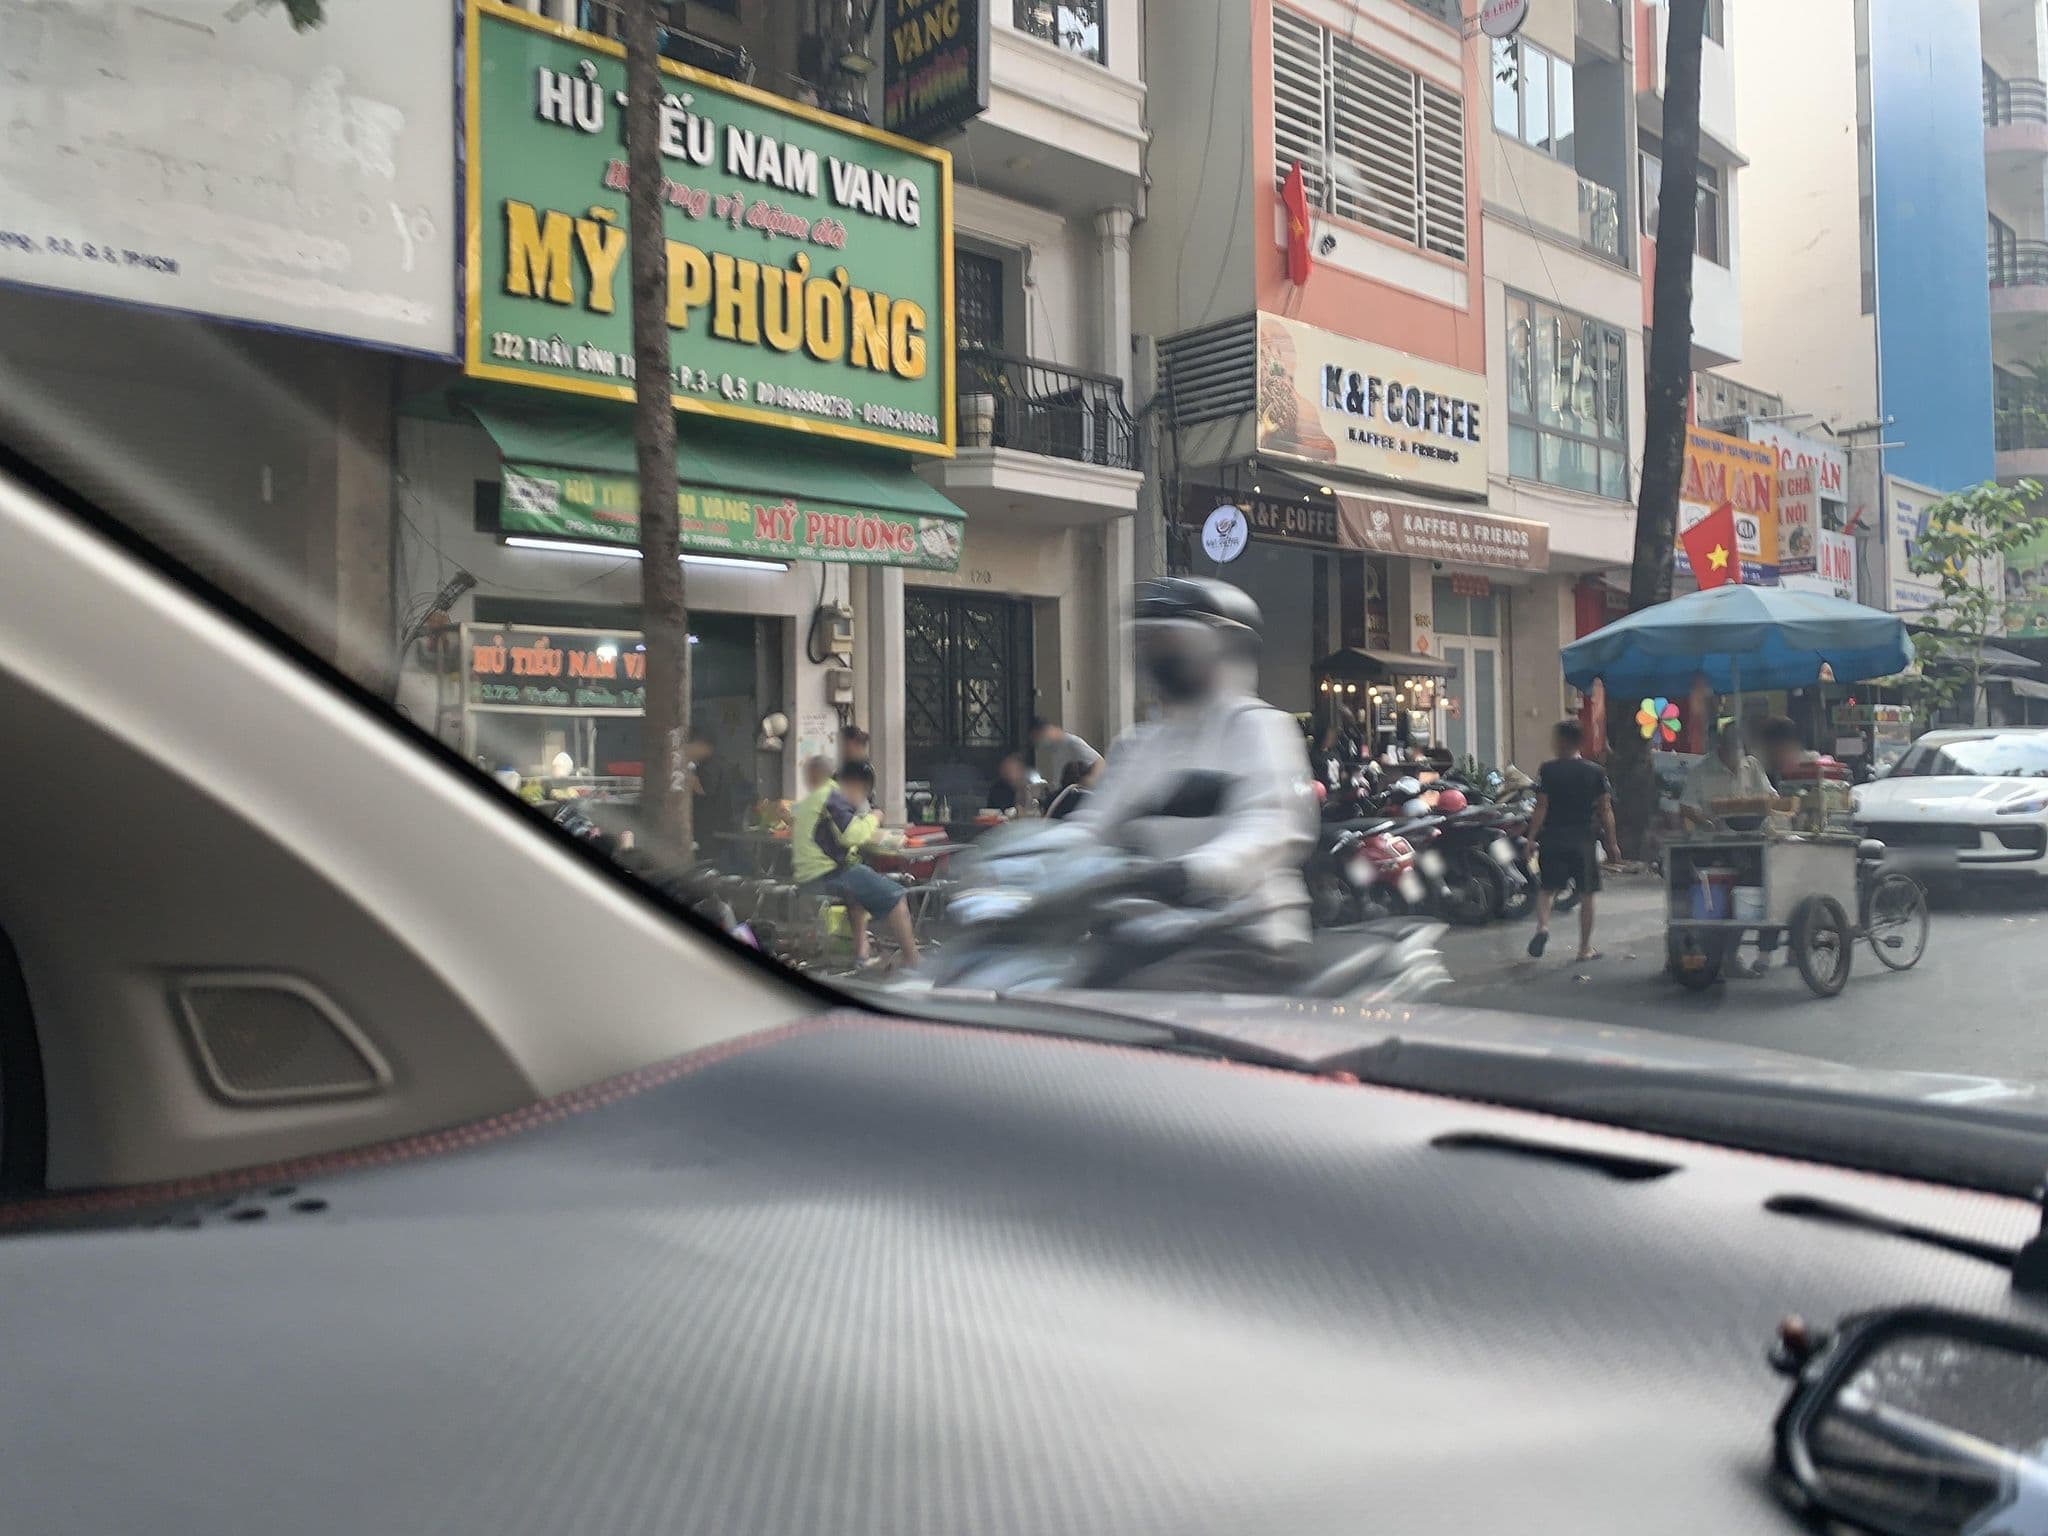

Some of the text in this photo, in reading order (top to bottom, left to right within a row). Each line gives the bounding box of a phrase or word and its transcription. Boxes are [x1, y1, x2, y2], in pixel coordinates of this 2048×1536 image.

[538, 59, 920, 227] HỦ ẾU NAM VANG
[605, 158, 848, 250] Hng vị đậm đà
[505, 199, 927, 380] MỸ PHƯƠNG
[491, 331, 525, 361] 172
[576, 339, 616, 376] BÌNH
[1320, 363, 1480, 442] K&F COFFEE
[1346, 426, 1395, 449] KAFFEE
[1410, 441, 1460, 464] FRIENDS
[1731, 467, 1771, 513] AN
[754, 498, 917, 553] MỸ PHƯƠNG
[1285, 506, 1336, 536] COFFE
[1402, 513, 1458, 538] KAFFEE
[1460, 523, 1471, 539] &
[1473, 524, 1530, 547] FRIENDS
[472, 635, 506, 674] HỦ
[568, 651, 617, 680] NAM
